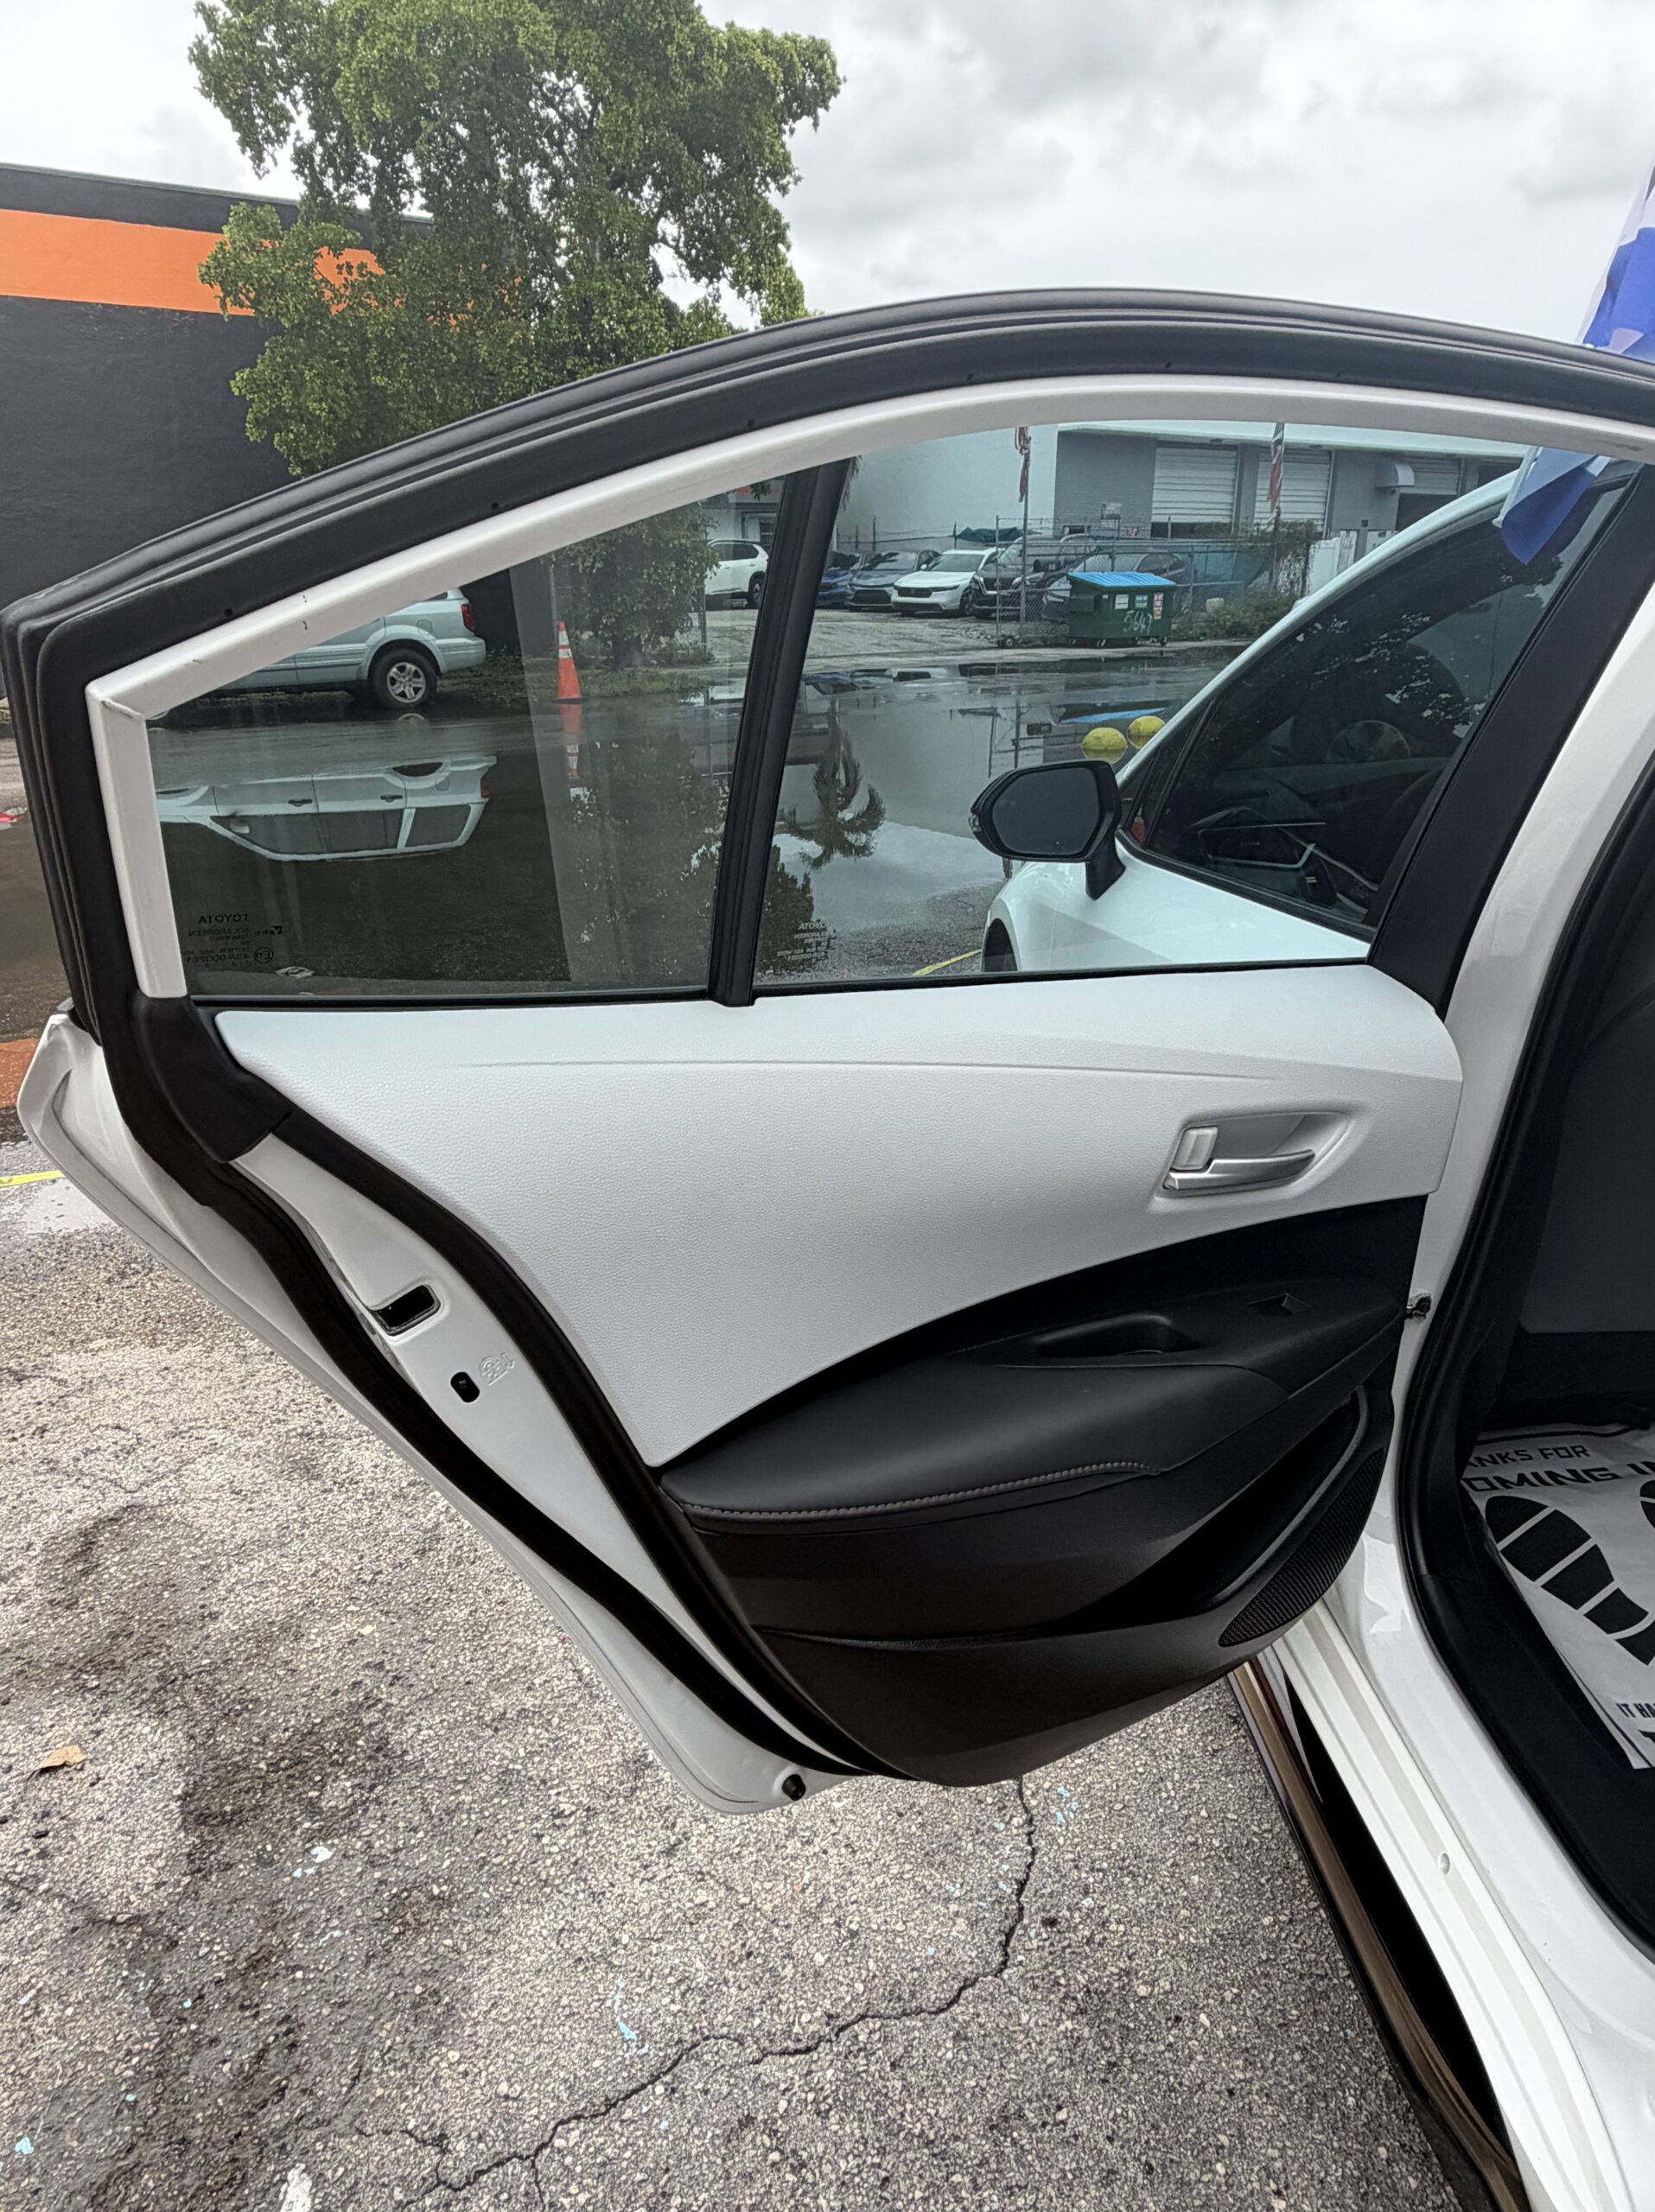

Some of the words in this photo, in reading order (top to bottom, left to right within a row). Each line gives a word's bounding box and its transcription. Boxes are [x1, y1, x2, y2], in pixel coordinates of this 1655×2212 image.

[1467, 1450, 1534, 1468] NKS
[1537, 1445, 1590, 1459] FOR
[1614, 1702, 1637, 1719] IT
